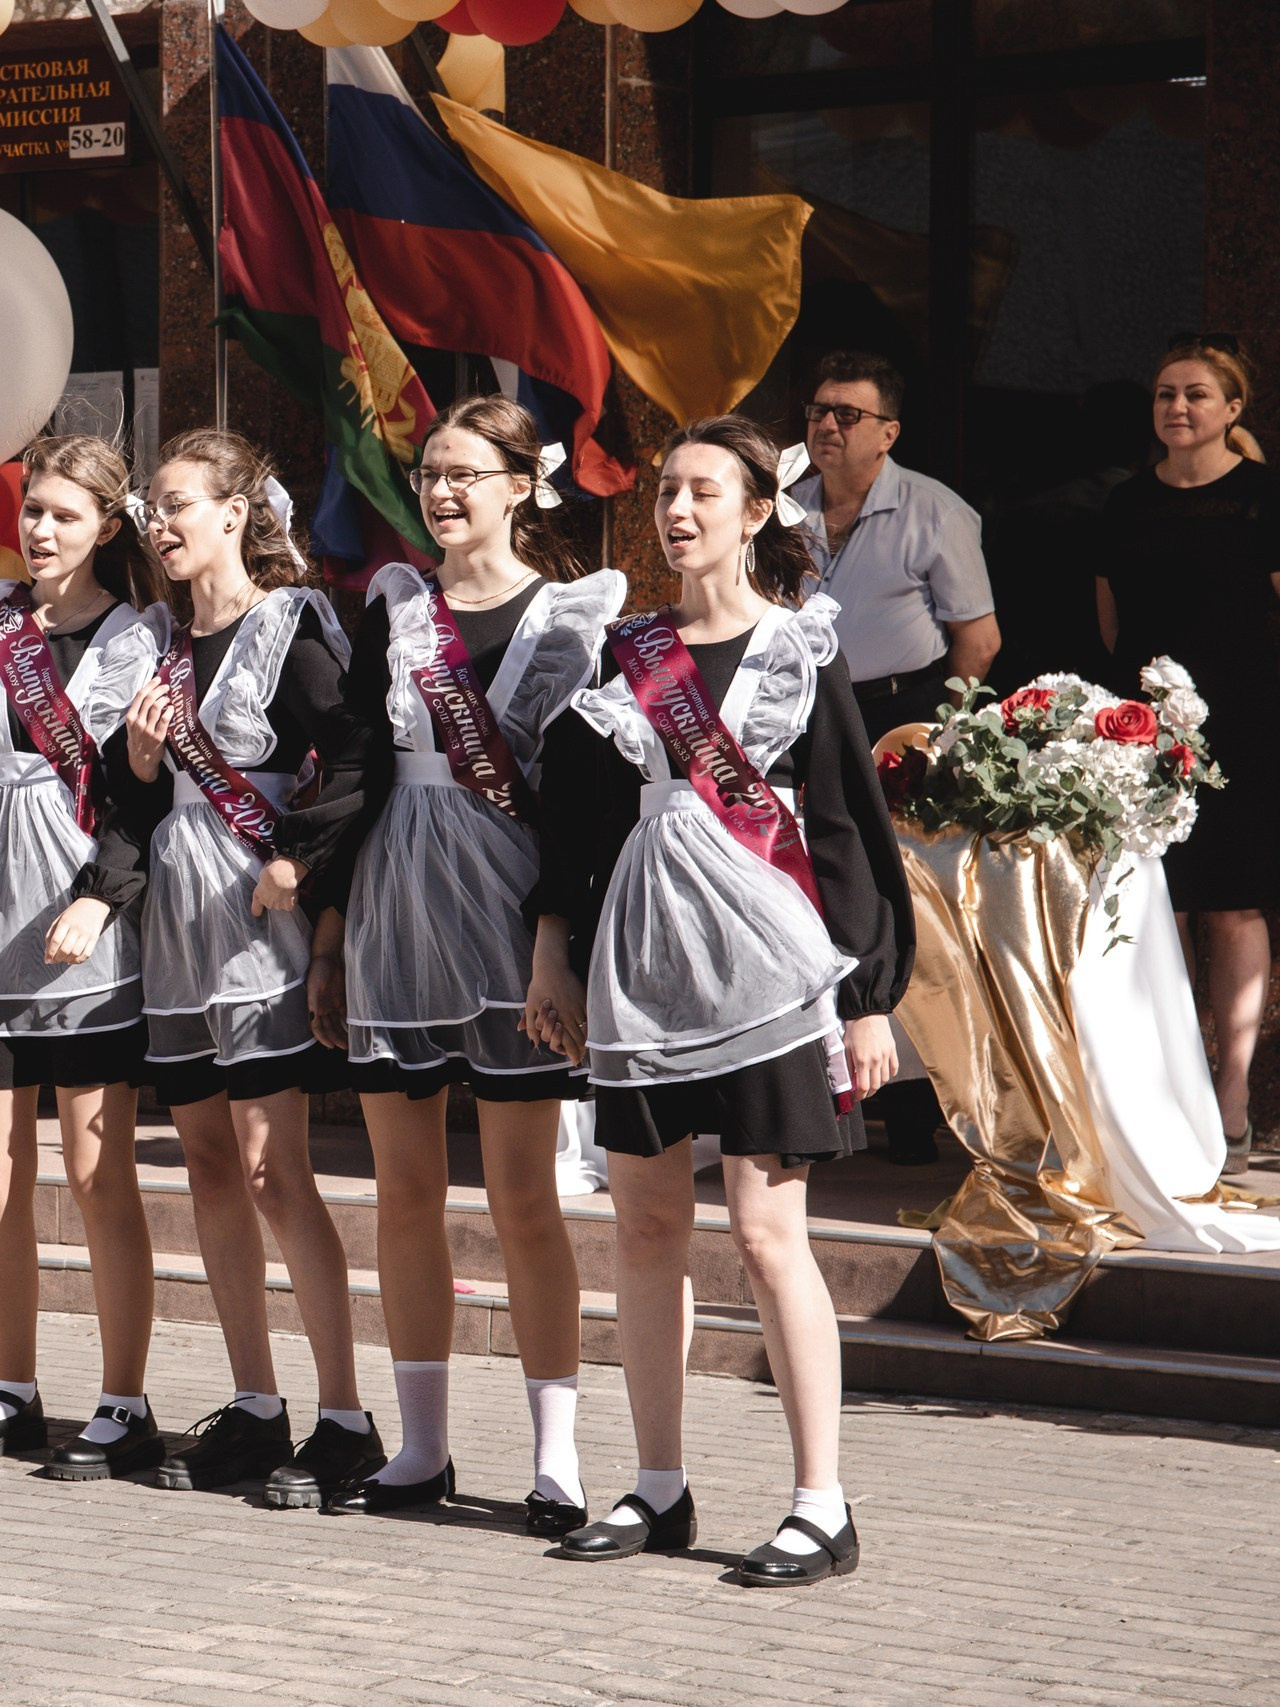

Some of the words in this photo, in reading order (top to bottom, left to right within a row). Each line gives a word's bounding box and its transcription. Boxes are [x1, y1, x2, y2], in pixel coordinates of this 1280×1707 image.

[3, 662, 20, 687] МАОУ
[38, 732, 56, 753] №33
[41, 667, 63, 712] Ларионова
[62, 708, 83, 741] Марина
[432, 698, 450, 724] СОШ
[626, 657, 647, 685] МАОУ
[655, 712, 673, 738] СОШ
[670, 739, 691, 762] №33
[633, 626, 739, 784] Выпускница
[194, 732, 213, 760] Алина
[221, 792, 276, 843] 202
[732, 782, 799, 851] 2024
